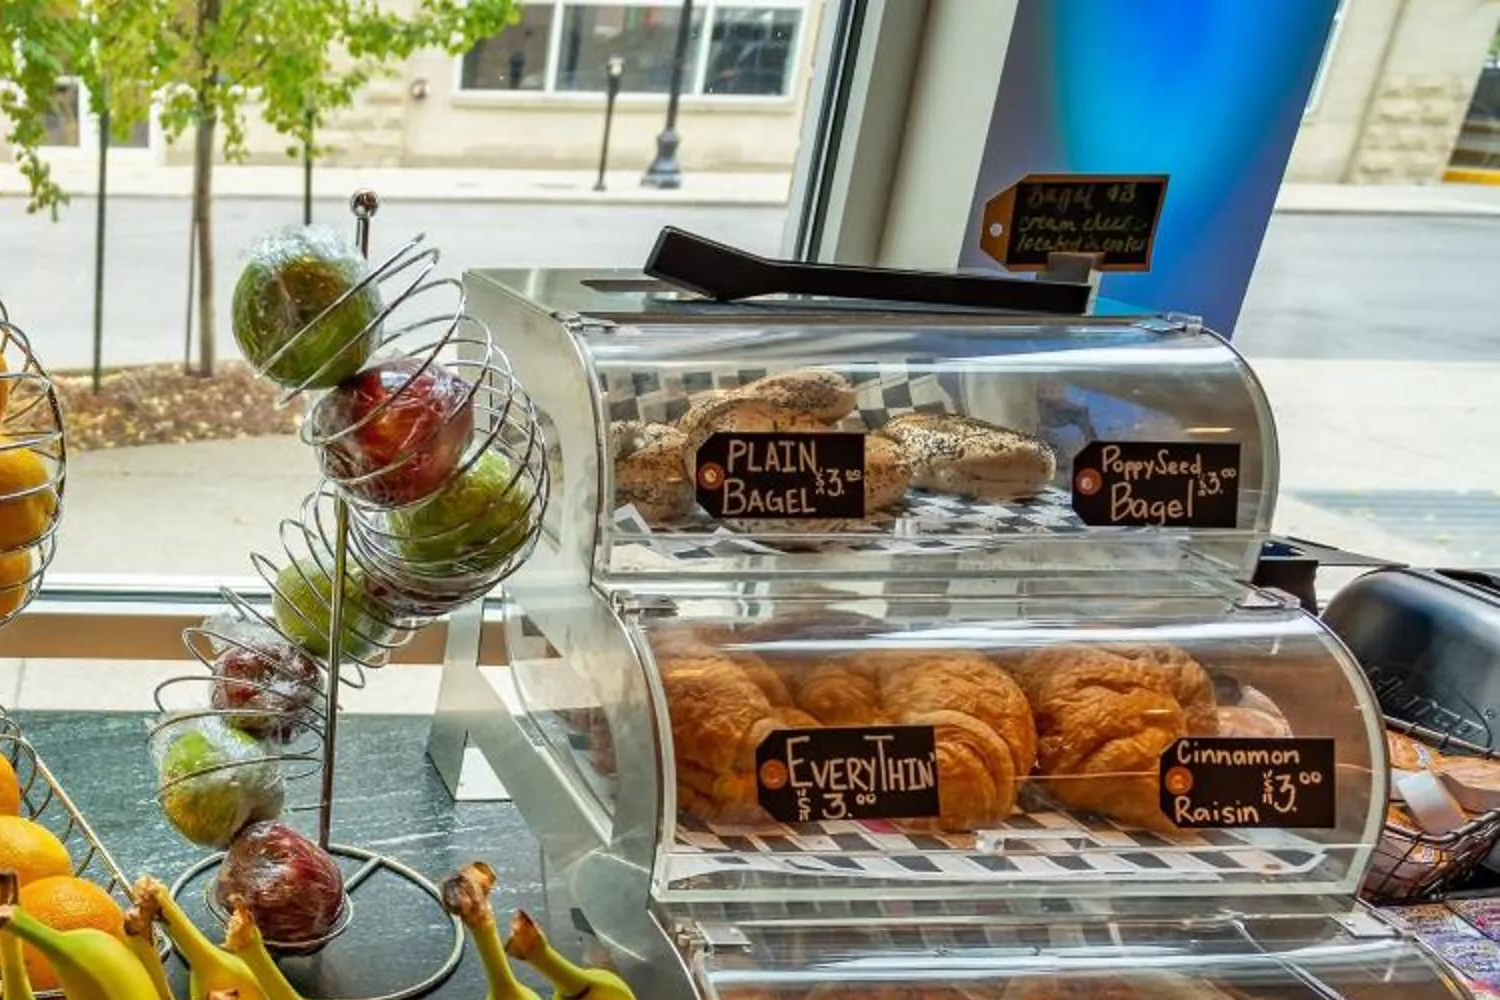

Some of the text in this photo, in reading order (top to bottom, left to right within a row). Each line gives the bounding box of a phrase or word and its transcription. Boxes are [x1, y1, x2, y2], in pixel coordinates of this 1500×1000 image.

[727, 439, 819, 475] PLAIN
[722, 477, 817, 515] BAGEL
[1111, 479, 1194, 525] Bagel
[1177, 740, 1300, 766] Cinnamon
[1174, 795, 1259, 823] Raisin
